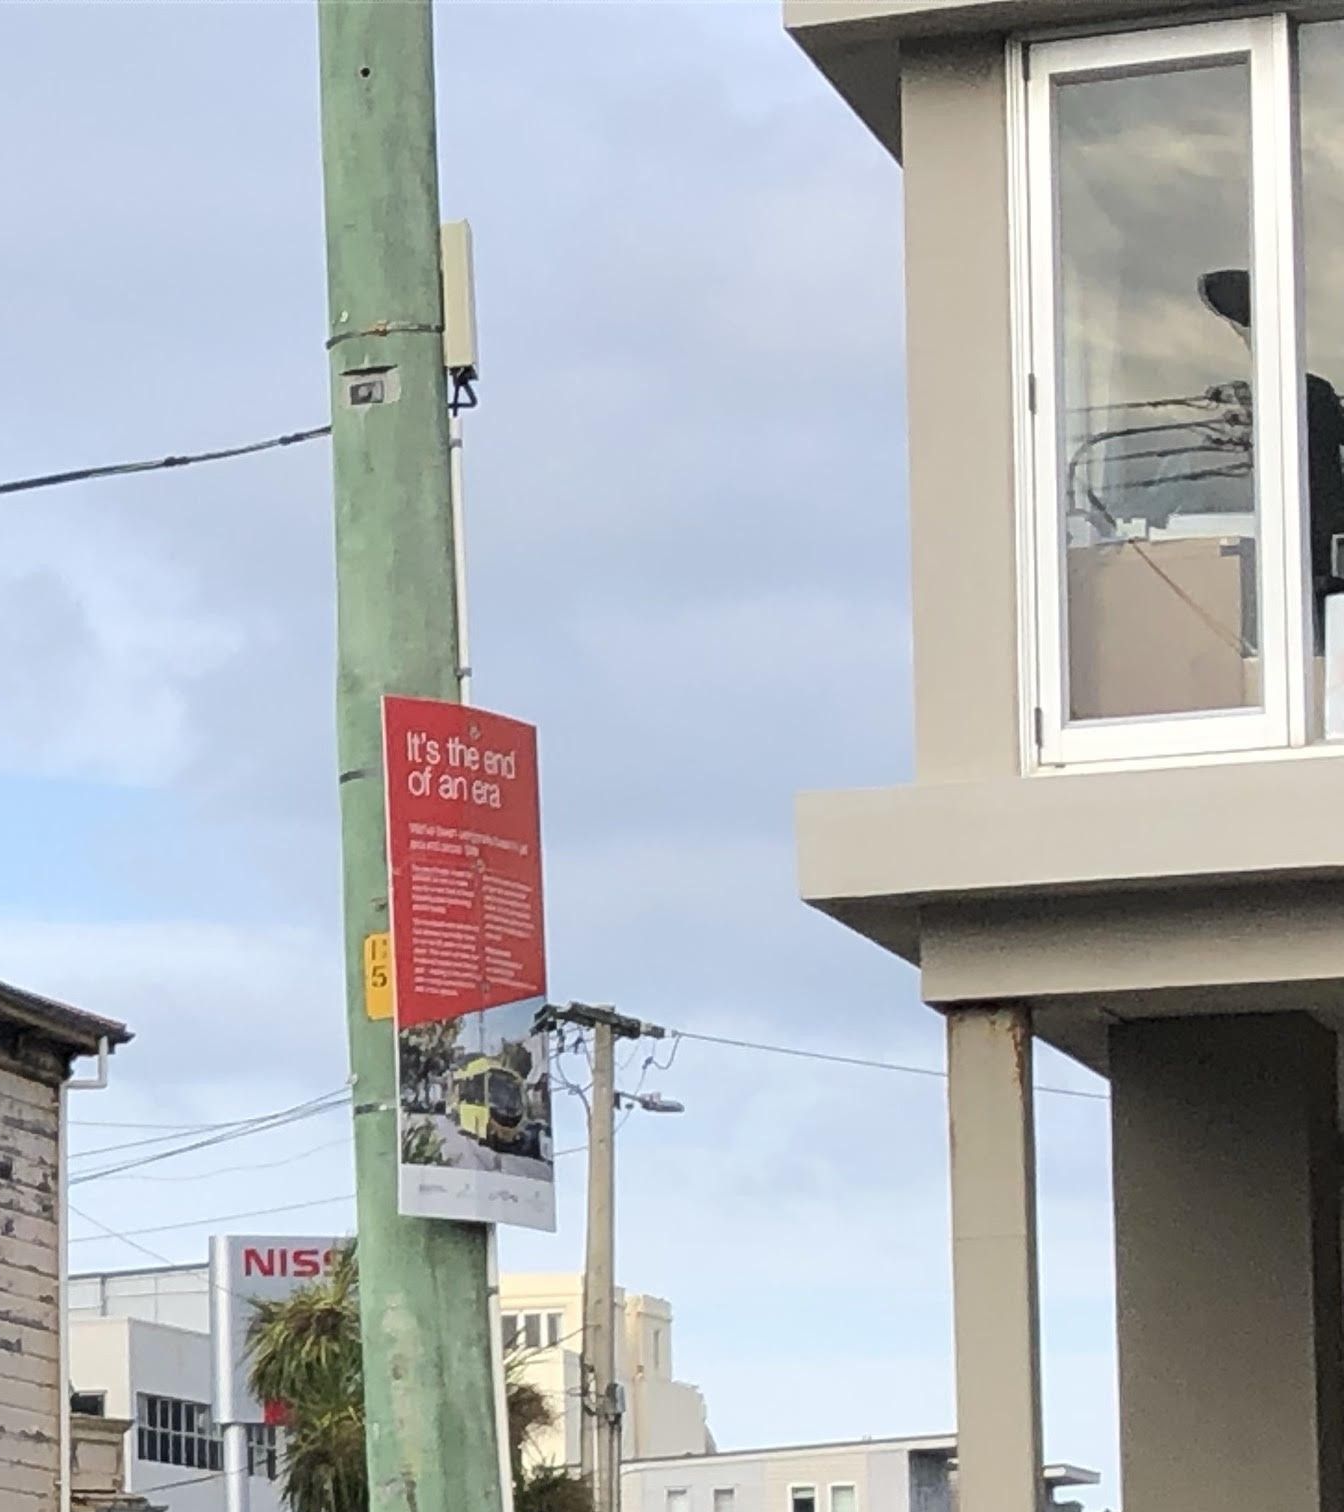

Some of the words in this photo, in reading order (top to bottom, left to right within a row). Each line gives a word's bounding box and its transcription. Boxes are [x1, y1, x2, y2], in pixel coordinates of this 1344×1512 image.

[406, 731, 441, 765] It's
[447, 737, 480, 770] the
[484, 751, 516, 779] end
[408, 766, 432, 797] of
[438, 774, 467, 801] an
[471, 779, 502, 808] era
[371, 965, 388, 988] 5
